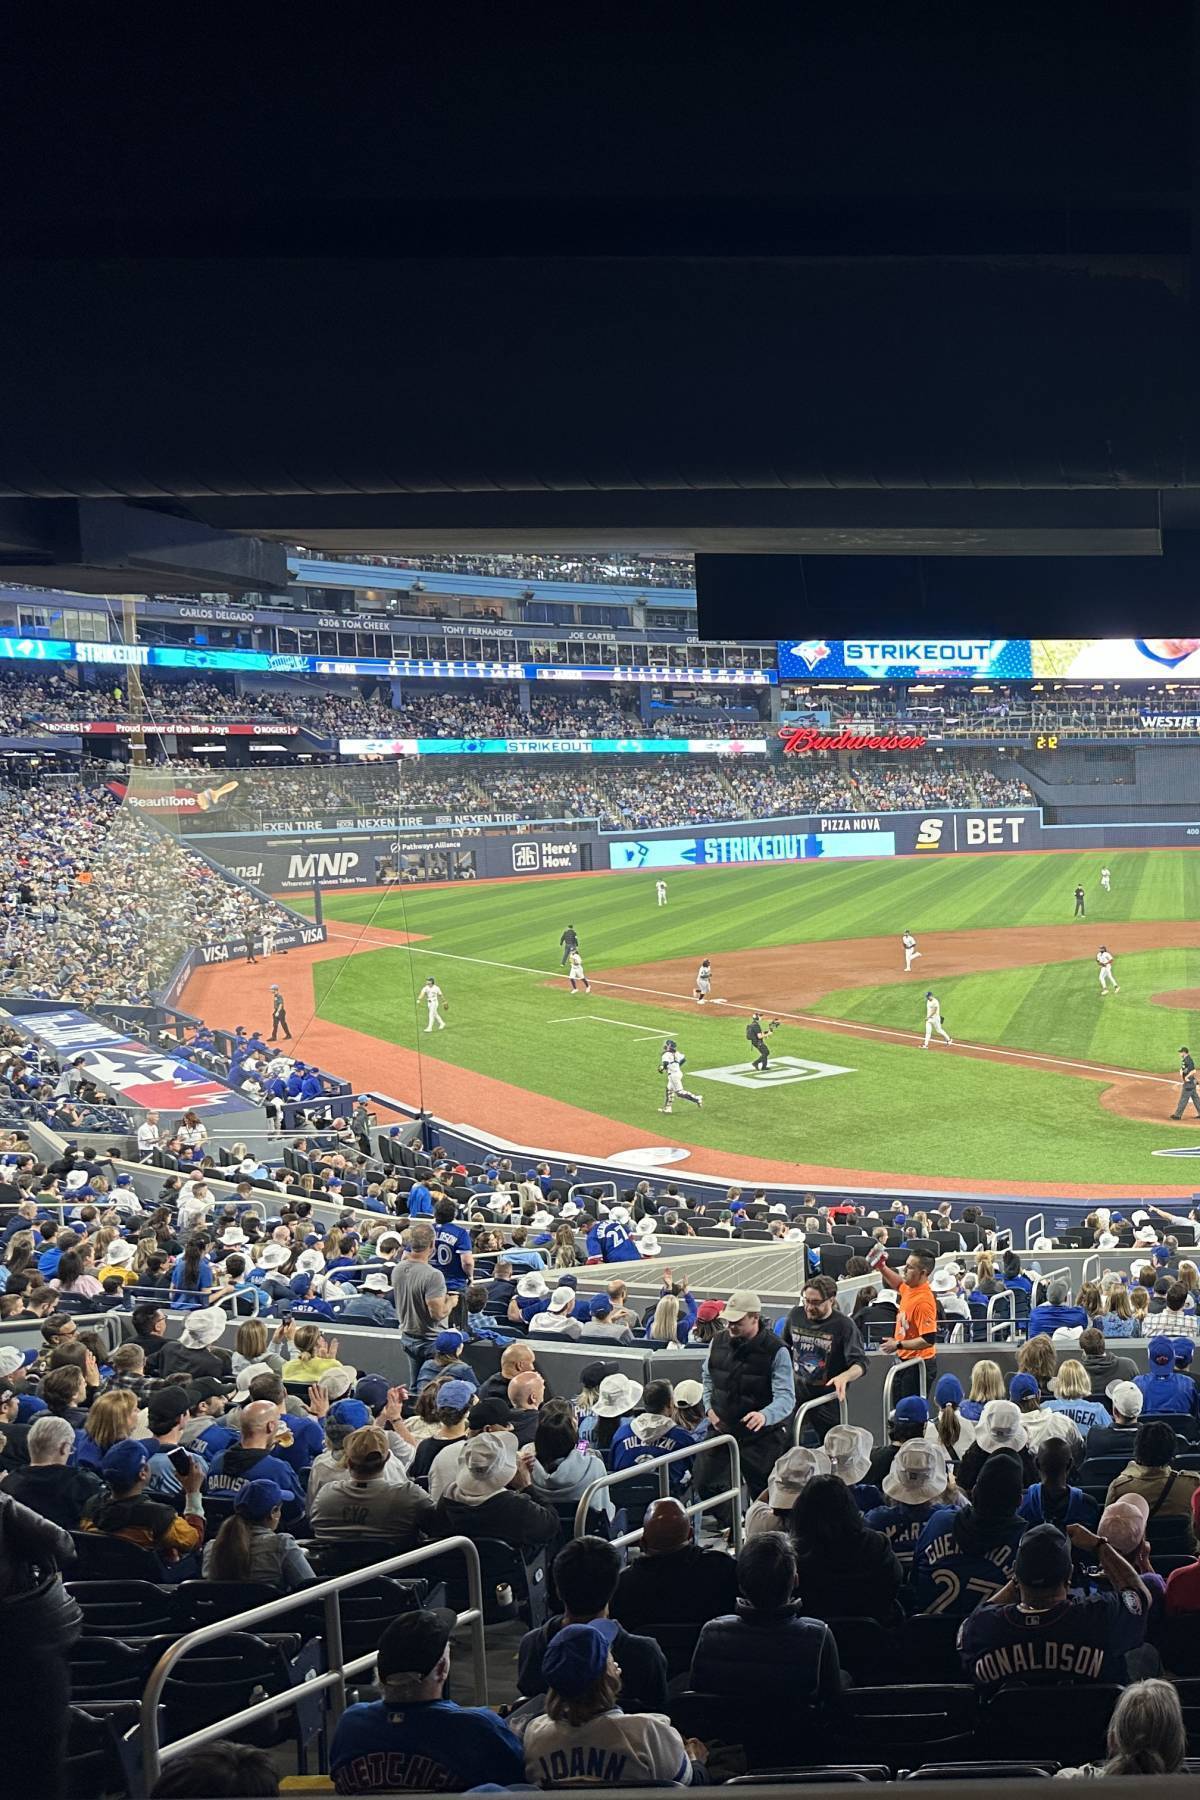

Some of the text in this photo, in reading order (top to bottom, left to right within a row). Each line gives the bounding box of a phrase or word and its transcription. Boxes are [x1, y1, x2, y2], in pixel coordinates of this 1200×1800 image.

[179, 607, 254, 622] CARLOS DELGADO
[318, 617, 390, 631] 4306 TOM CHEEK
[442, 625, 513, 637] TONY FERNANDEZ
[568, 631, 616, 641] JOE CARTER
[846, 643, 989, 660] STRIKEOUT
[49, 724, 79, 732] ROGERS
[116, 724, 229, 735] Proud owner of the Blue Jays
[261, 726, 288, 734] ROGERS
[778, 727, 926, 753] Budweiser
[507, 741, 592, 753] STRIKEOUT
[129, 797, 195, 808] BeautiTone
[295, 820, 322, 830] TIRE
[357, 818, 395, 829] NEXEN
[399, 816, 424, 826] TIRE
[455, 814, 493, 825] NEXEN
[821, 818, 880, 832] PIZZA NOVA
[966, 817, 1025, 845] BET
[1186, 828, 1199, 836] 400
[402, 841, 461, 851] Pathways Alliance
[542, 841, 577, 855] Here's
[704, 835, 809, 864] STRIKEOUT
[287, 851, 359, 879] MNP
[542, 855, 572, 868] How.
[300, 927, 324, 944] VISA
[200, 944, 229, 962] VISA
[974, 1641, 1104, 1682] DONALDSON
[538, 1746, 628, 1785] JOANN
